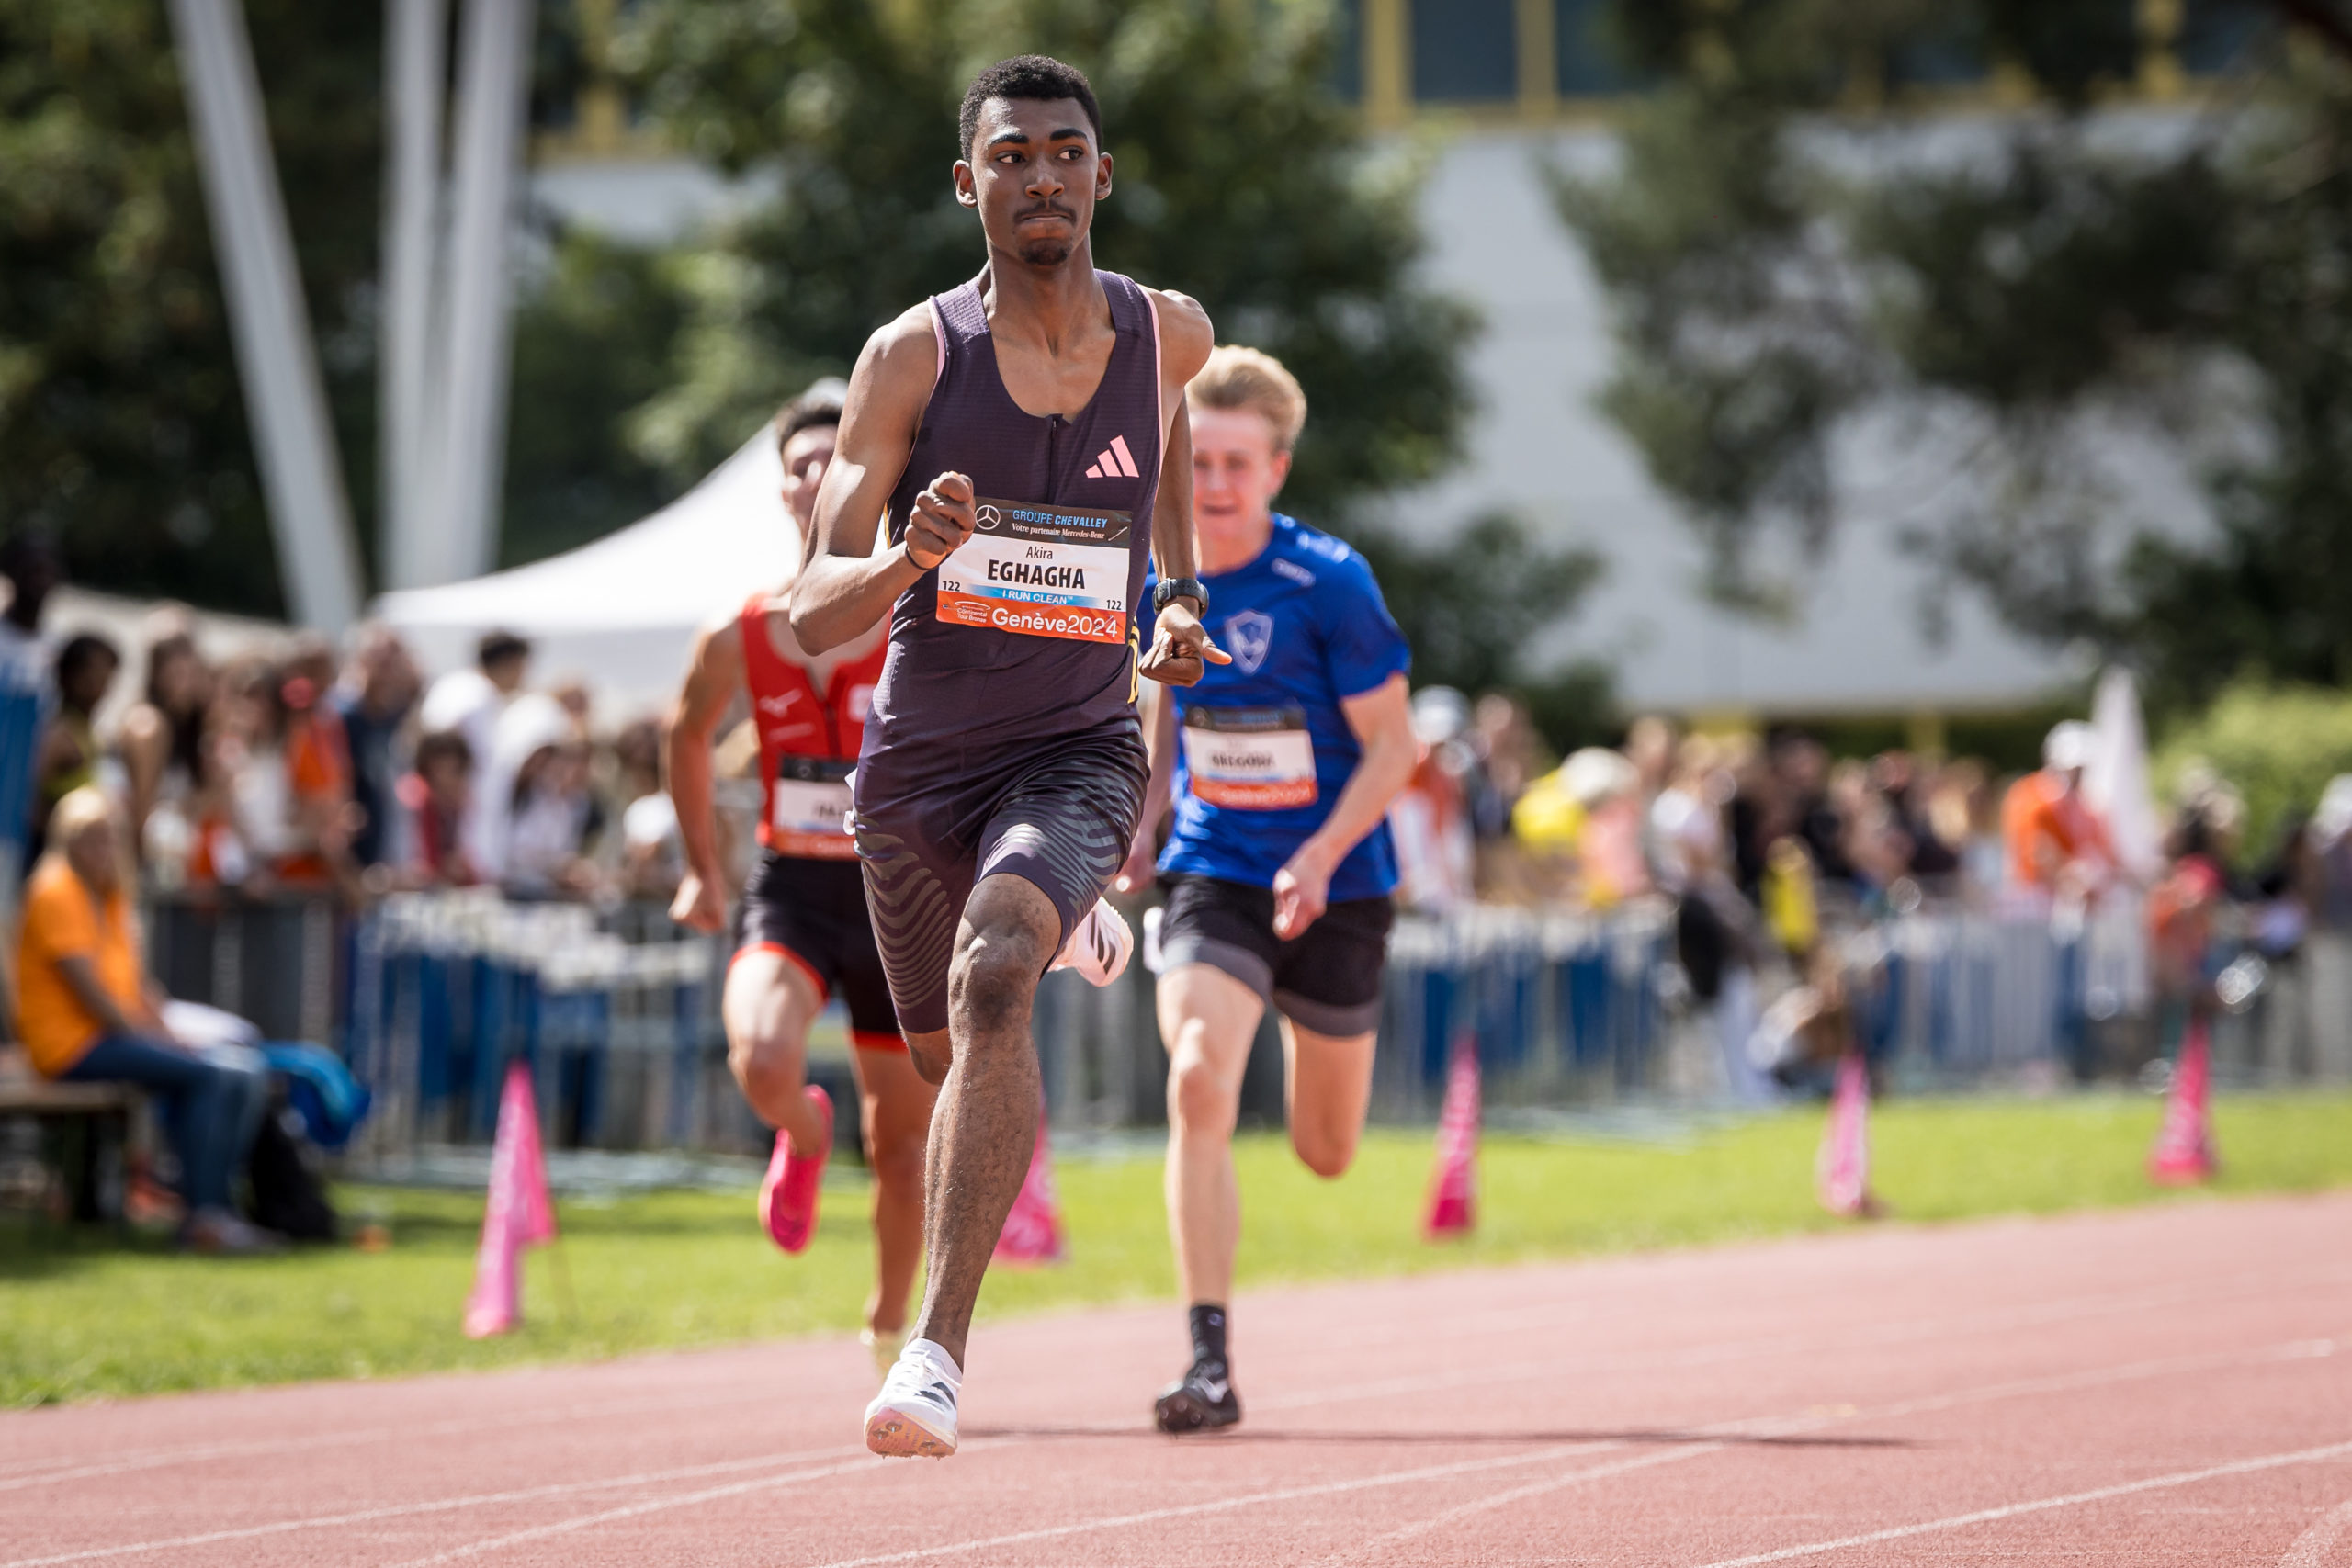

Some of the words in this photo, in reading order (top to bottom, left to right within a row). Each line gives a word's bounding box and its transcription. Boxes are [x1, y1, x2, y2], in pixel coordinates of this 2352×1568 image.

[1012, 510, 1053, 524] GROUPE
[1055, 514, 1108, 528] CHEVALLEY
[1012, 523, 1029, 532] Votre
[1030, 526, 1061, 535] partenaire
[1061, 528, 1105, 539] Mercedes-Benz
[1025, 546, 1053, 559] Akira
[987, 559, 1085, 590] EGHAGHA
[942, 580, 961, 592] 122
[1002, 589, 1007, 598] I
[1008, 590, 1031, 601] RUN
[1106, 599, 1122, 611] 122
[991, 606, 1118, 637] Genève2024
